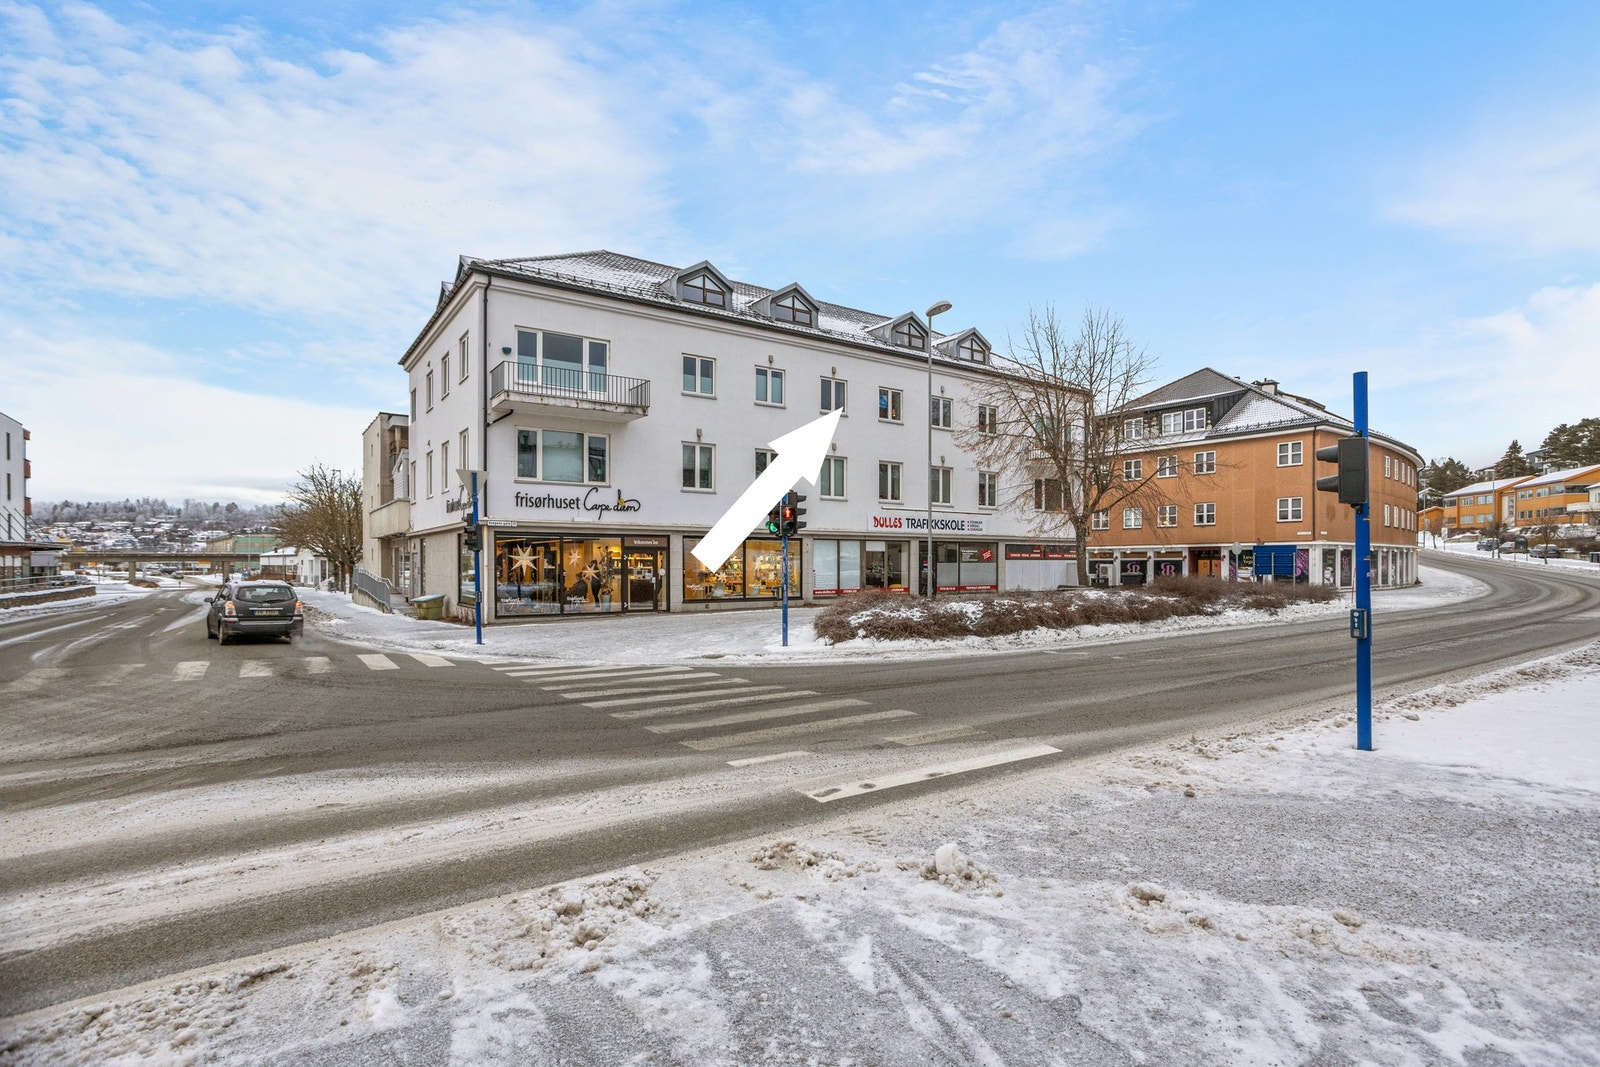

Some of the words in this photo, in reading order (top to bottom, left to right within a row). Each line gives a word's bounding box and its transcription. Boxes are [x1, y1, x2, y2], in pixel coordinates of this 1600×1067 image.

[515, 491, 581, 510] frisørhuset
[583, 487, 612, 520] Carpe
[873, 516, 903, 529] DULLES
